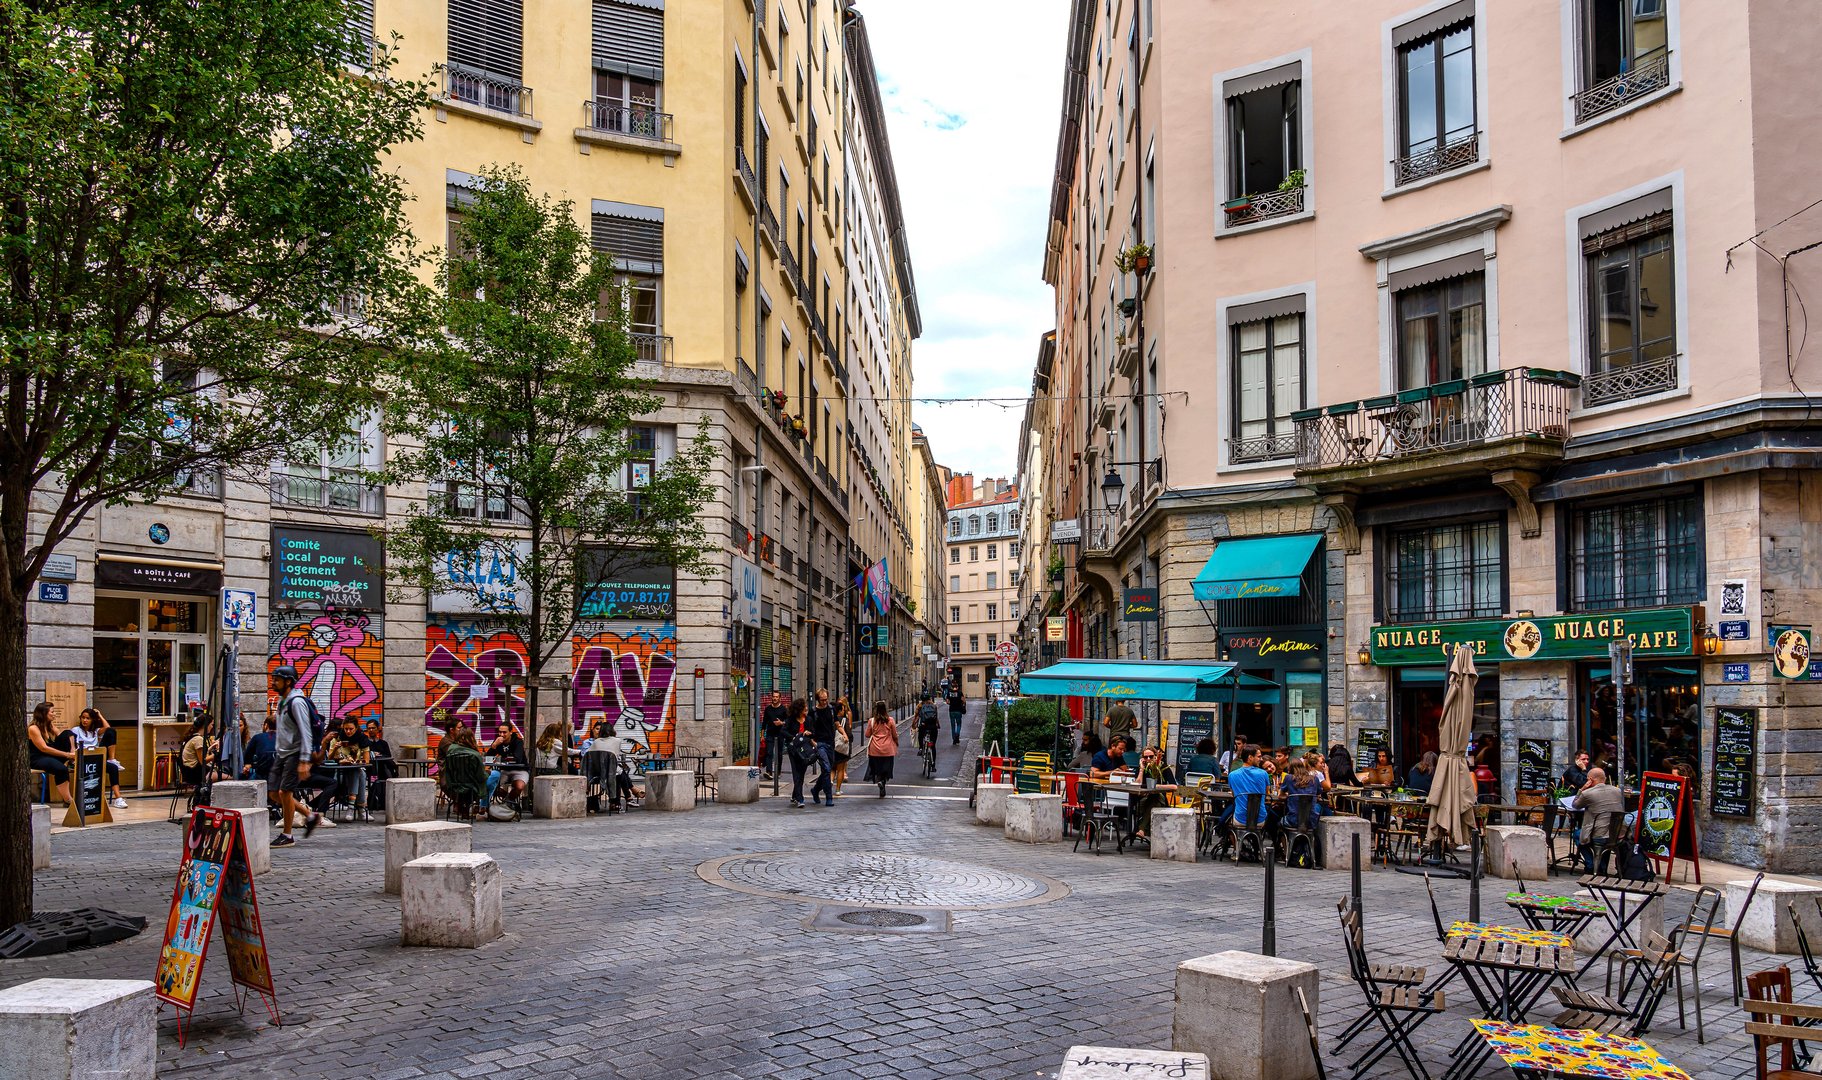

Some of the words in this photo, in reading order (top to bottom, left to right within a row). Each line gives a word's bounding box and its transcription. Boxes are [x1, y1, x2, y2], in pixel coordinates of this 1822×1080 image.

[280, 538, 320, 550] Comité
[281, 551, 310, 562] Local
[320, 555, 346, 565] pour
[354, 556, 363, 565] le
[280, 563, 336, 576] Logement
[282, 576, 340, 587] Autonome
[349, 580, 368, 590] des
[1238, 582, 1284, 598] Cantina
[282, 588, 324, 599] Jeunes.
[582, 591, 670, 603] 4.72.07.87.17
[1554, 619, 1624, 640] NUAGE
[1377, 630, 1441, 648] NUAGE
[1628, 631, 1677, 648] CAFE
[1259, 637, 1315, 656] Cantina
[1442, 641, 1486, 656] CAFE
[85, 764, 96, 773] ICE
